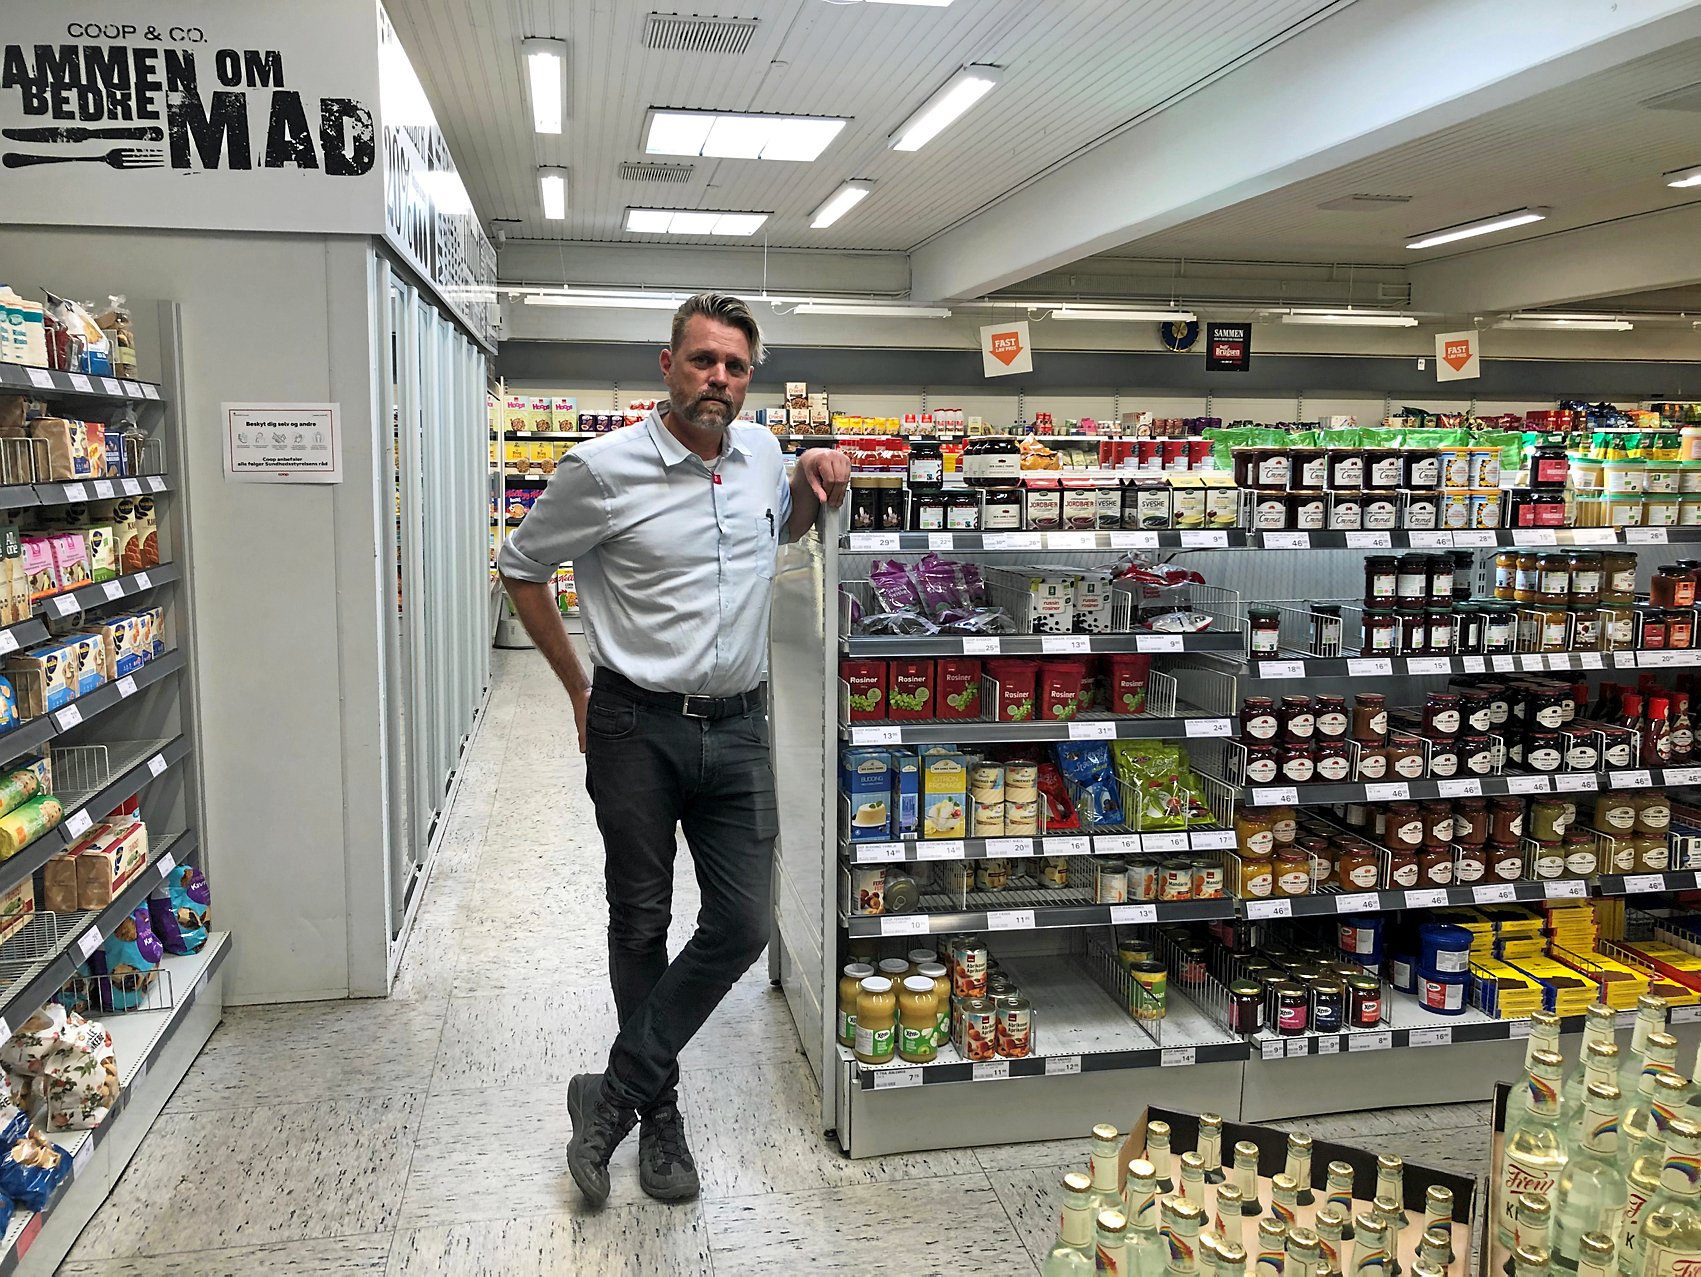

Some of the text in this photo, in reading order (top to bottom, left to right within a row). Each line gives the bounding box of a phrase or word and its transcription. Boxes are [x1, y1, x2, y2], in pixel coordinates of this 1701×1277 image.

[67, 23, 208, 43] COOP & CO.
[215, 49, 285, 88] OM
[22, 79, 160, 122] BEDRE
[167, 90, 375, 176] MAD
[1214, 329, 1244, 337] SAMMEN
[995, 337, 1016, 348] FAST
[1447, 345, 1467, 354] FAST
[1004, 691, 1030, 699] Rosiner
[1051, 691, 1075, 699] Rosiner
